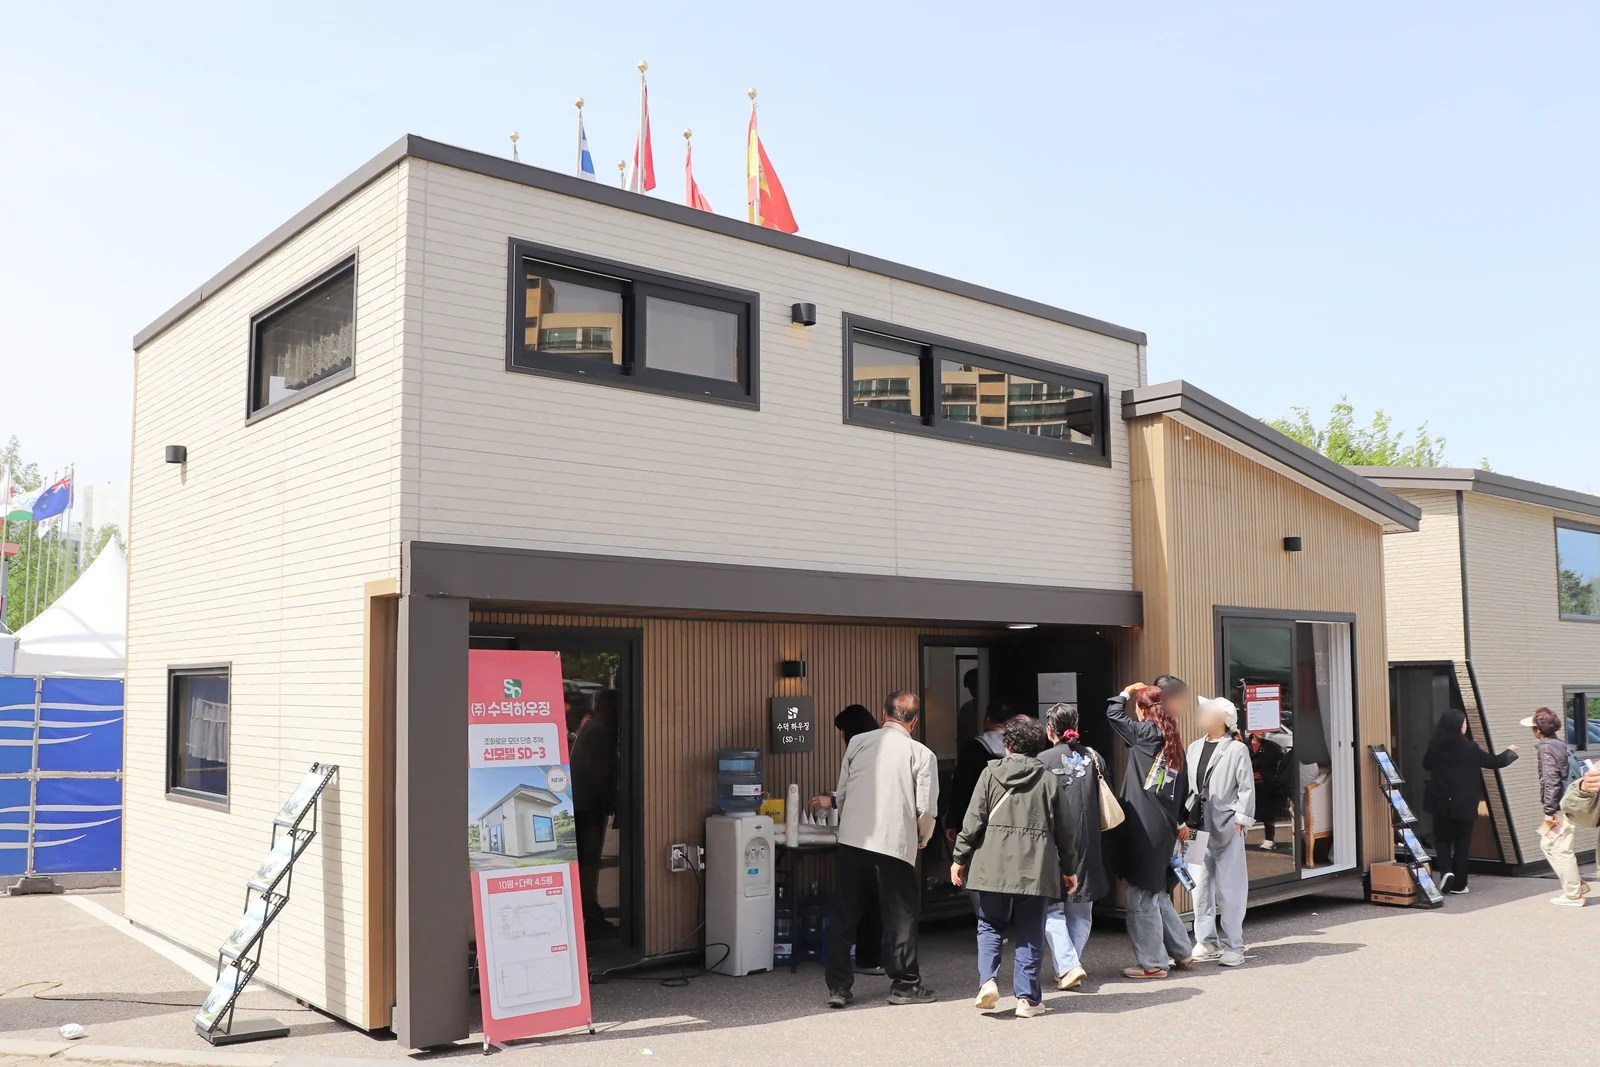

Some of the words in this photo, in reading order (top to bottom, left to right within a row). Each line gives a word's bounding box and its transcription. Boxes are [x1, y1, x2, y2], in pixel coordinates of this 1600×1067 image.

[471, 702, 486, 717] (주)
[488, 701, 551, 717] 수덕하우징
[776, 722, 789, 732] 수덕
[791, 721, 810, 731] 하우징
[483, 747, 516, 761] 신모델
[517, 746, 547, 760] SD-3
[499, 878, 533, 889] 10평+다락
[535, 876, 553, 886] 4.5평
